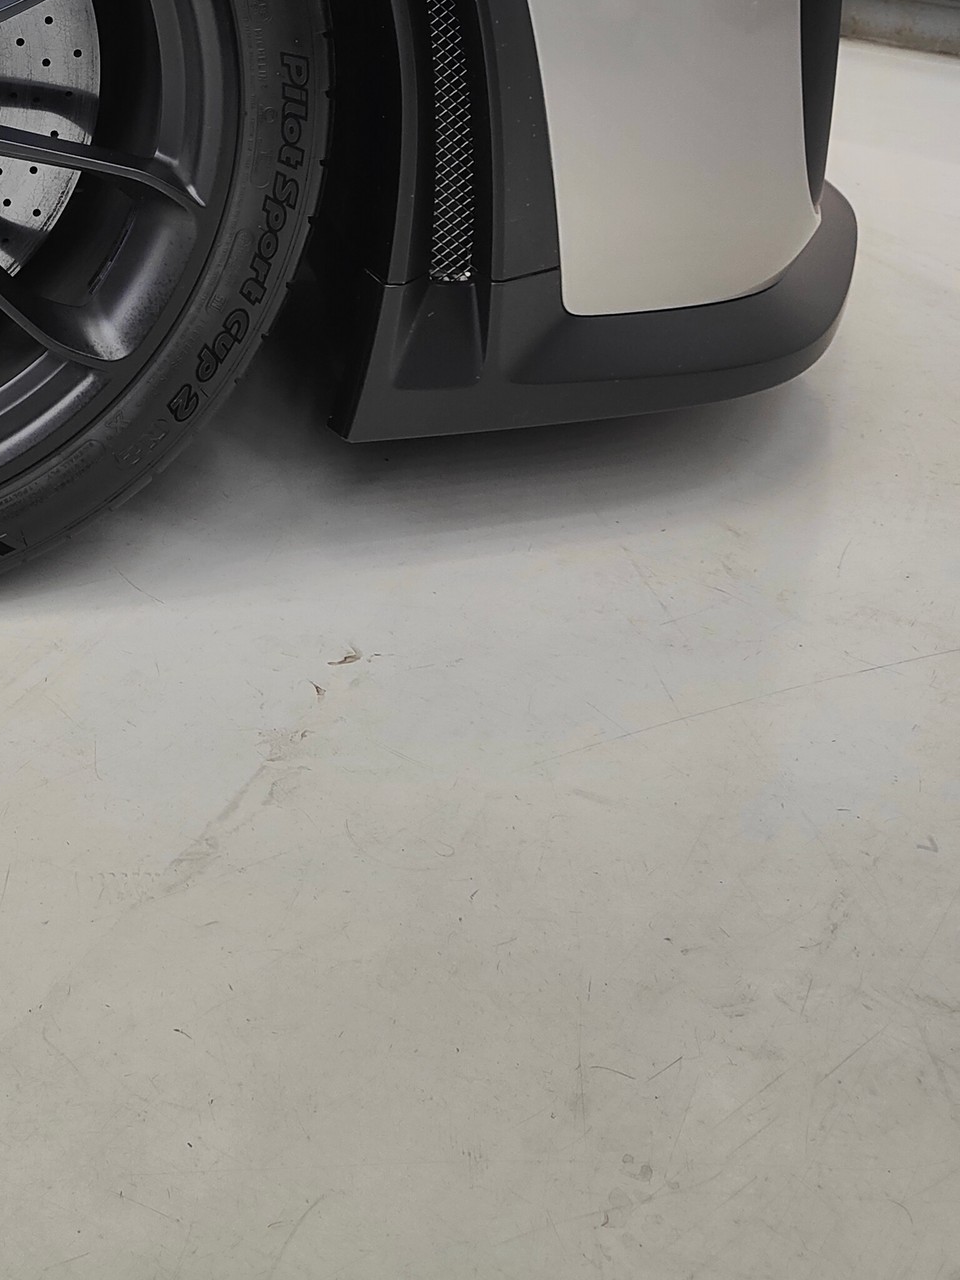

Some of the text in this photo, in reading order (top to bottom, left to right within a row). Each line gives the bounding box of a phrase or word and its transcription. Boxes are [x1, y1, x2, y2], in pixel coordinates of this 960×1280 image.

[277, 51, 310, 170] Pilot
[239, 173, 300, 306] Sport
[195, 307, 252, 384] Cup
[167, 383, 200, 422] 2
